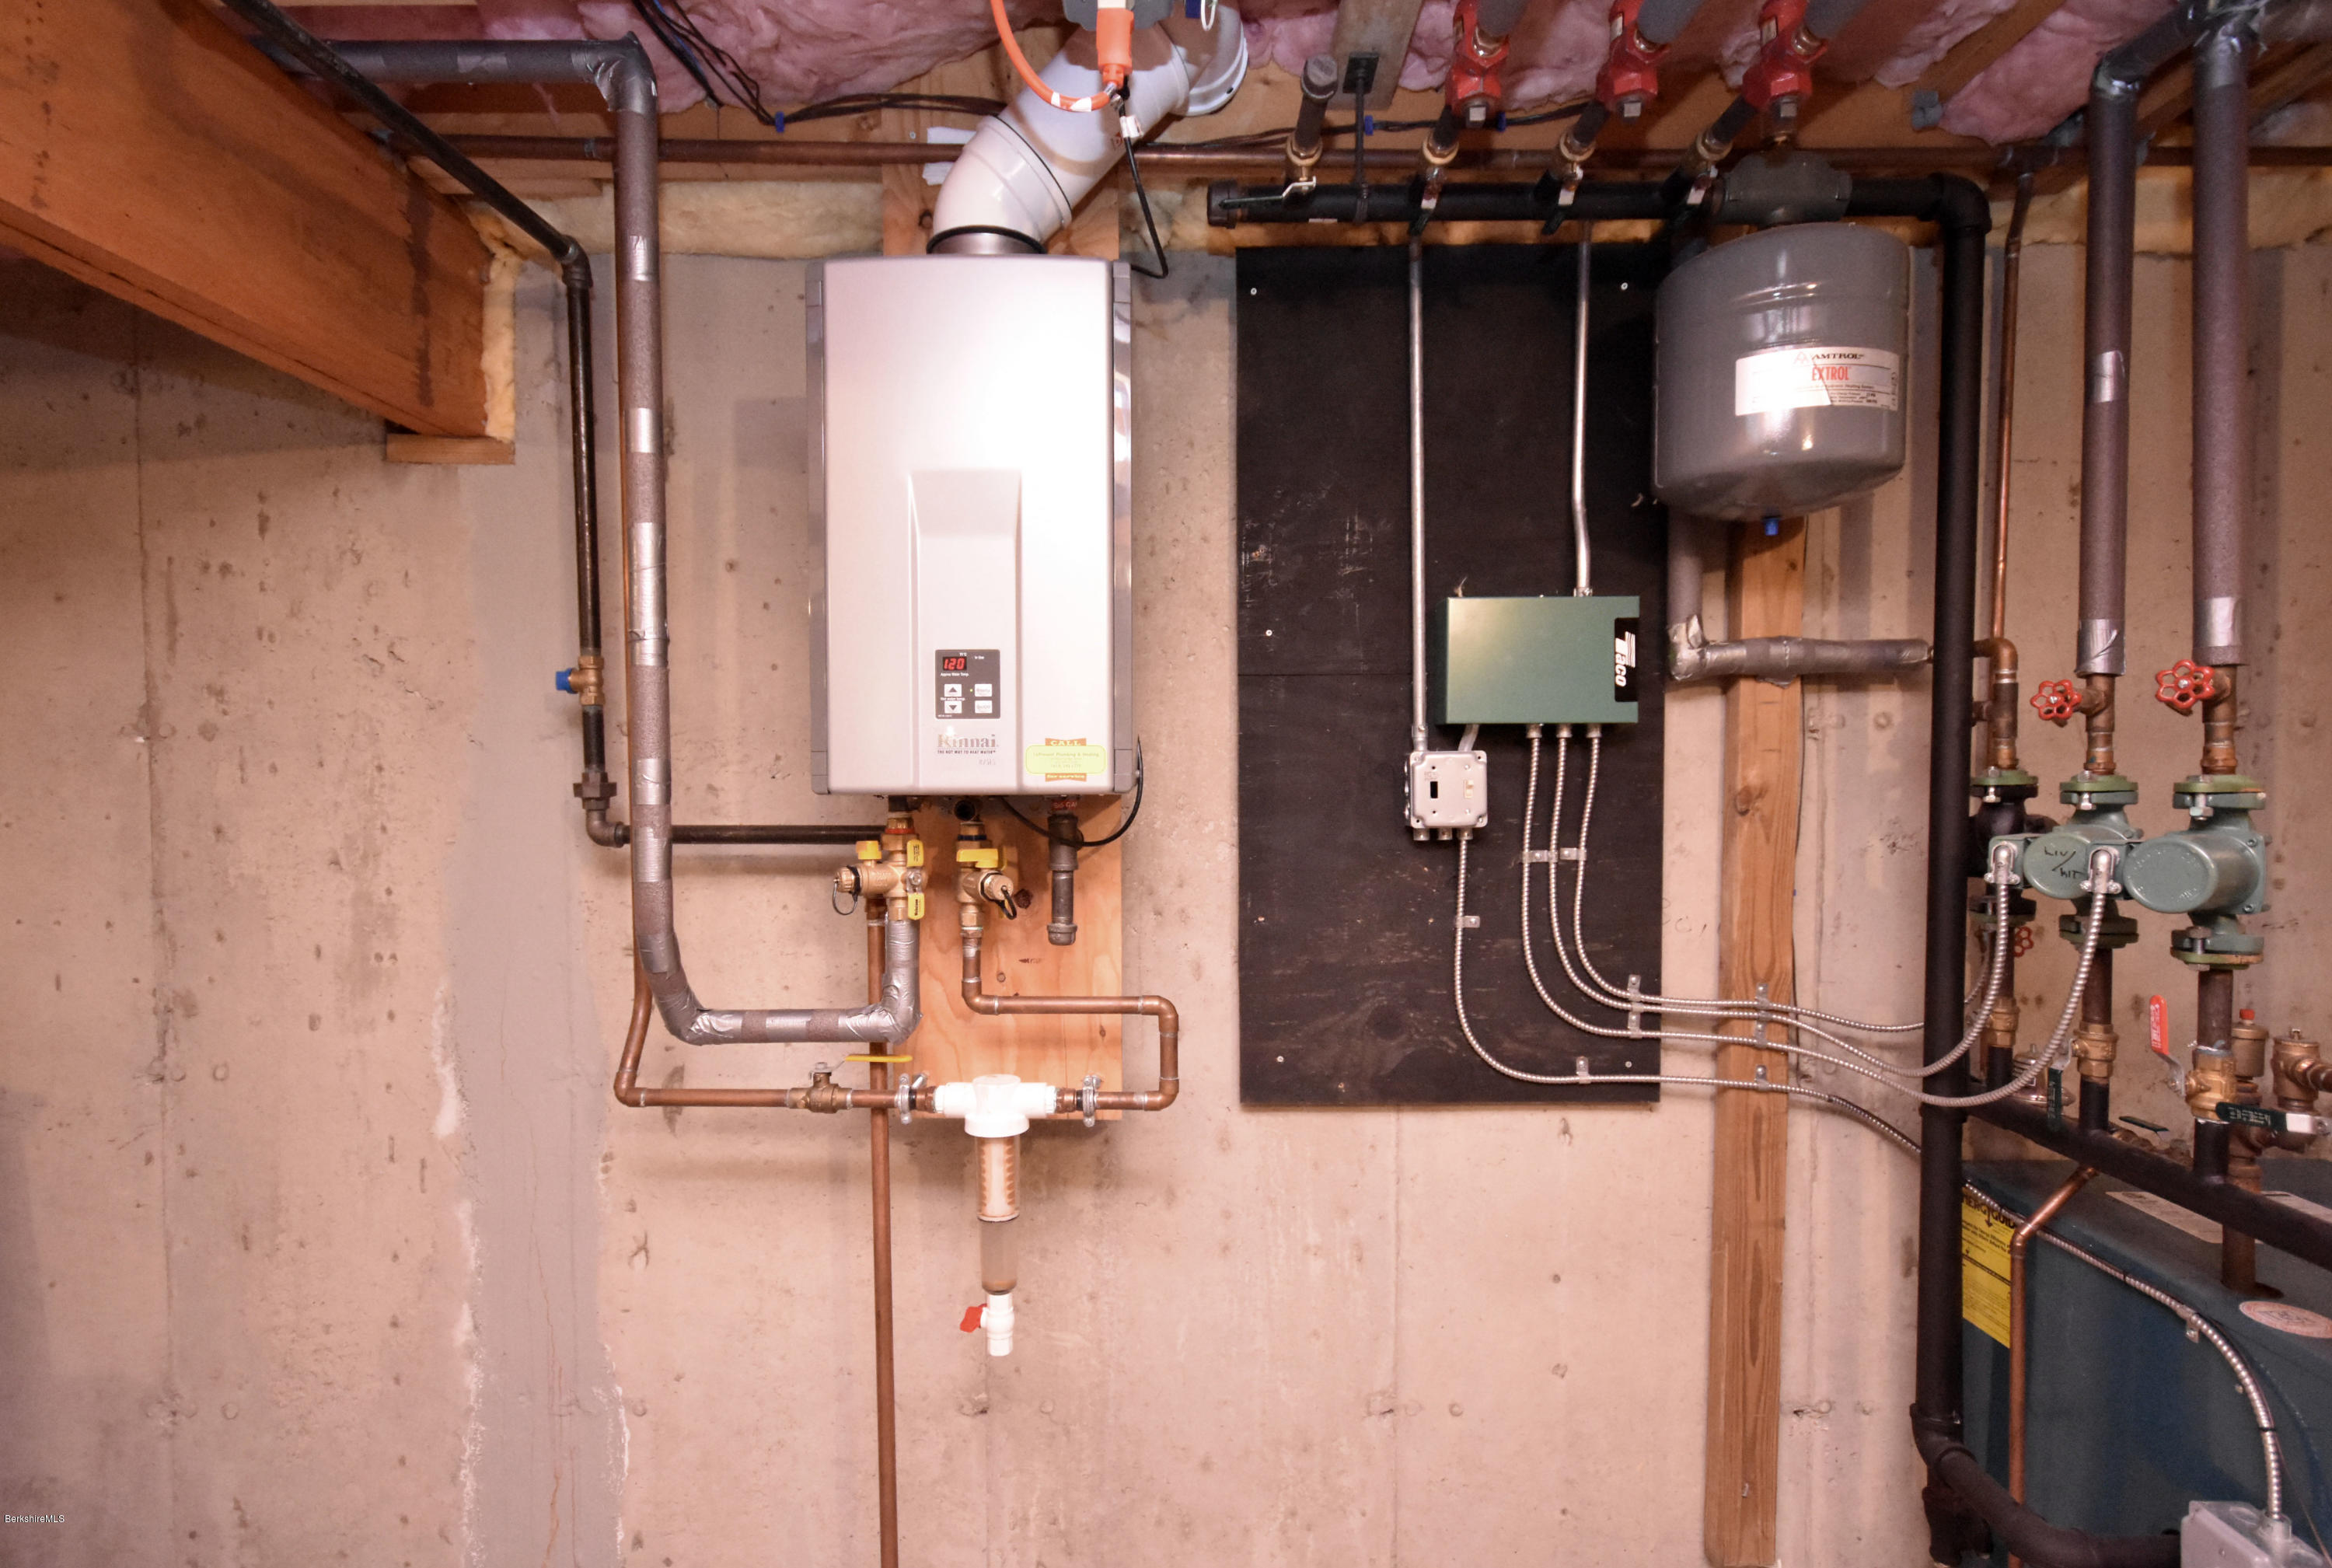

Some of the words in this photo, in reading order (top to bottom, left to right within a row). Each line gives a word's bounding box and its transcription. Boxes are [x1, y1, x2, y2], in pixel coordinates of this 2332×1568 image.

[1812, 366, 1850, 381] EXTROL
[944, 658, 965, 669] 120
[1615, 630, 1636, 687] Taco
